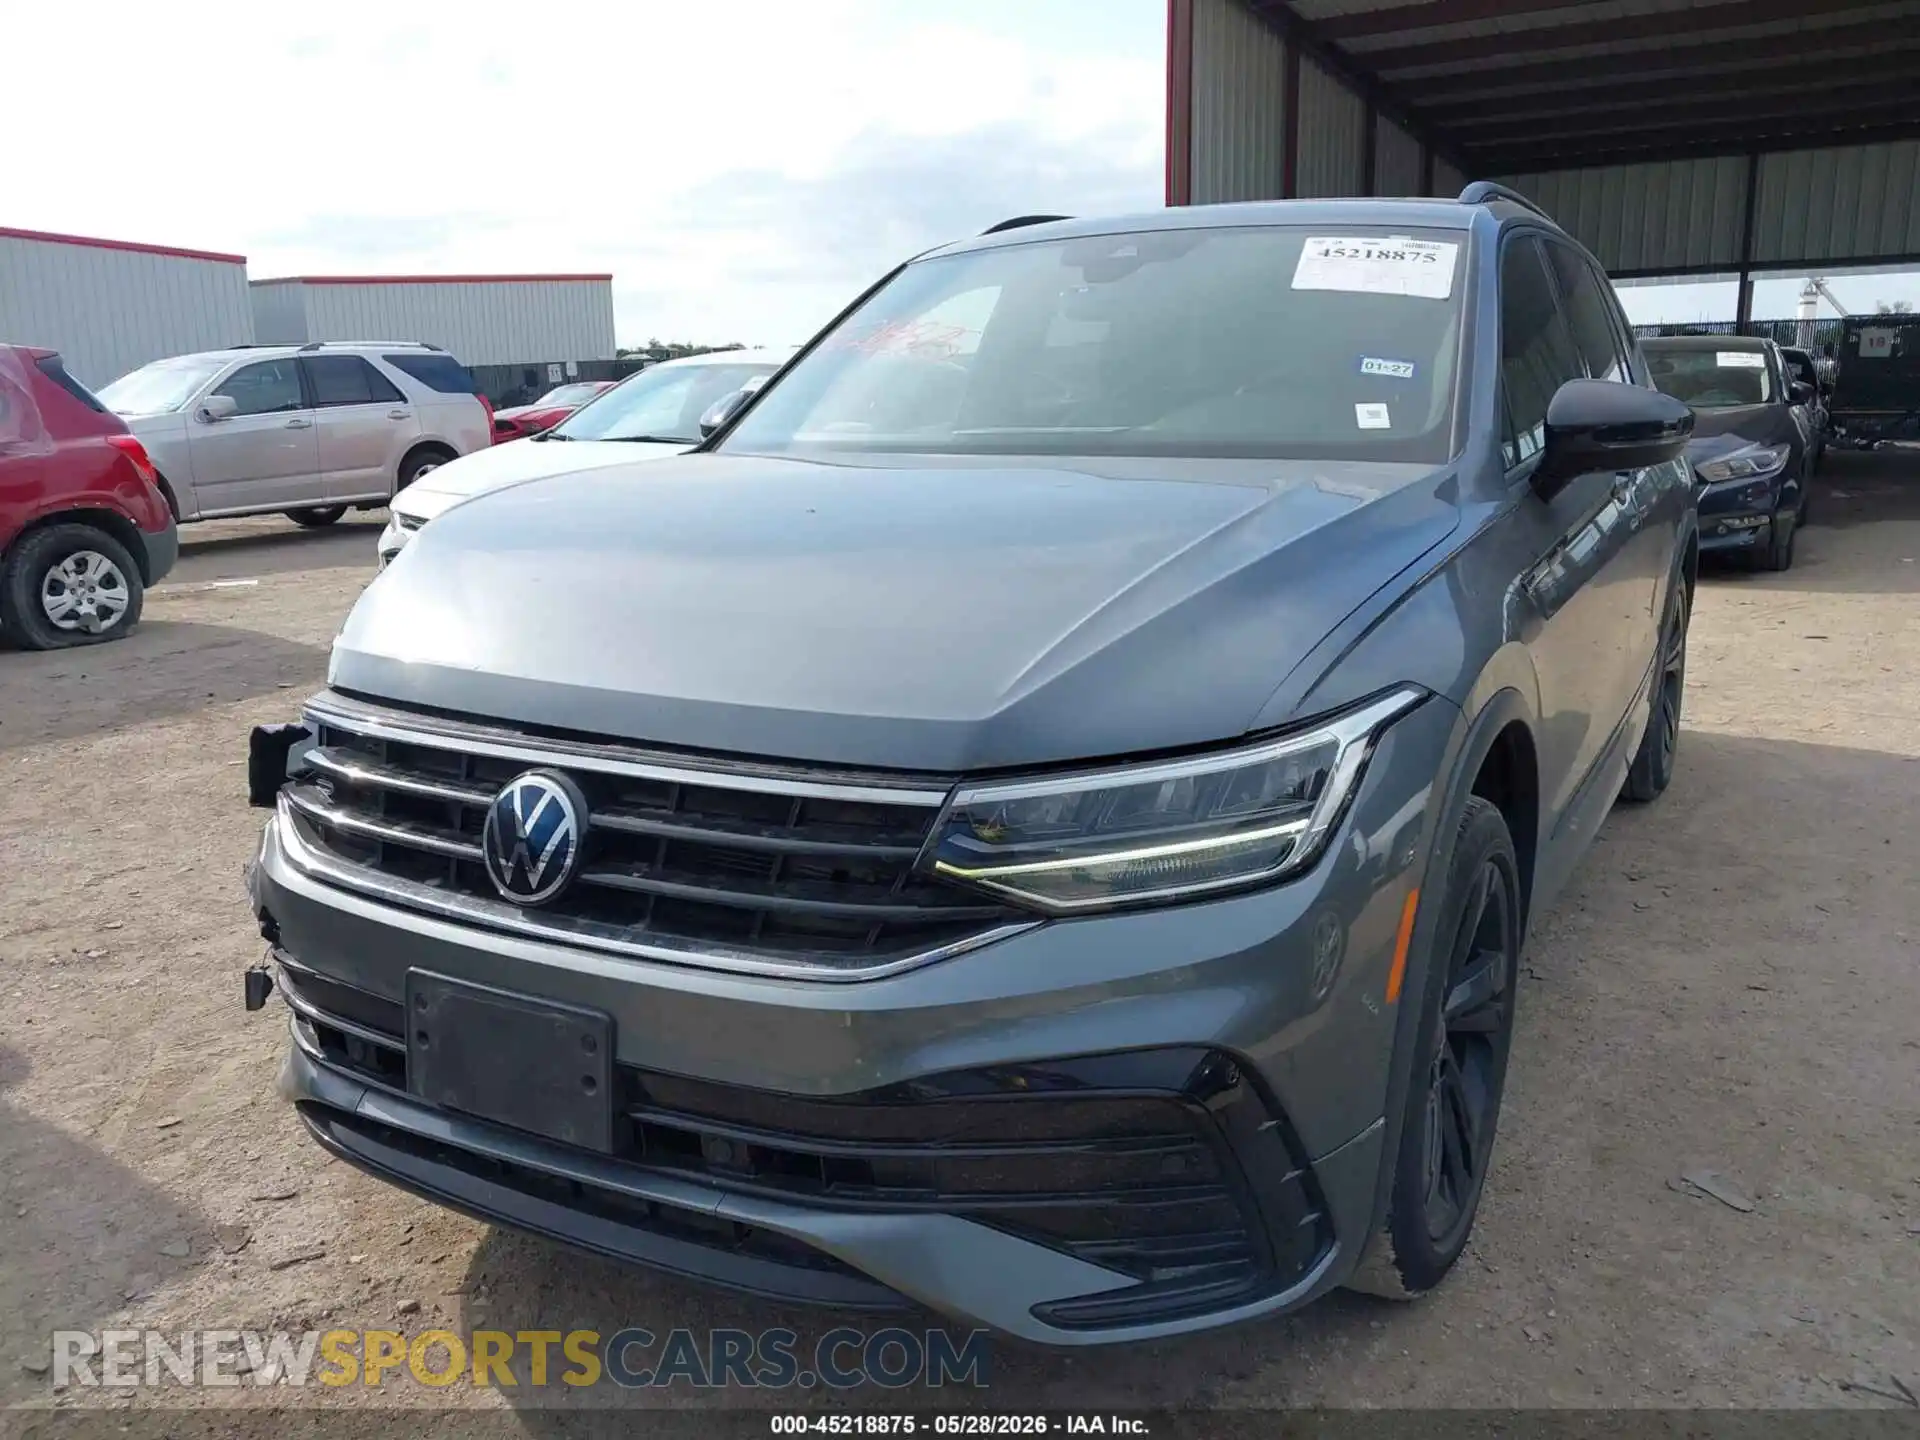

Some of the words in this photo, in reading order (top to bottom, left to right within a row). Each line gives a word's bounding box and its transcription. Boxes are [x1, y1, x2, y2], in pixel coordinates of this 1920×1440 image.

[1317, 248, 1437, 263] 45218875
[1364, 360, 1412, 374] 01-27
[487, 778, 576, 895] VW
